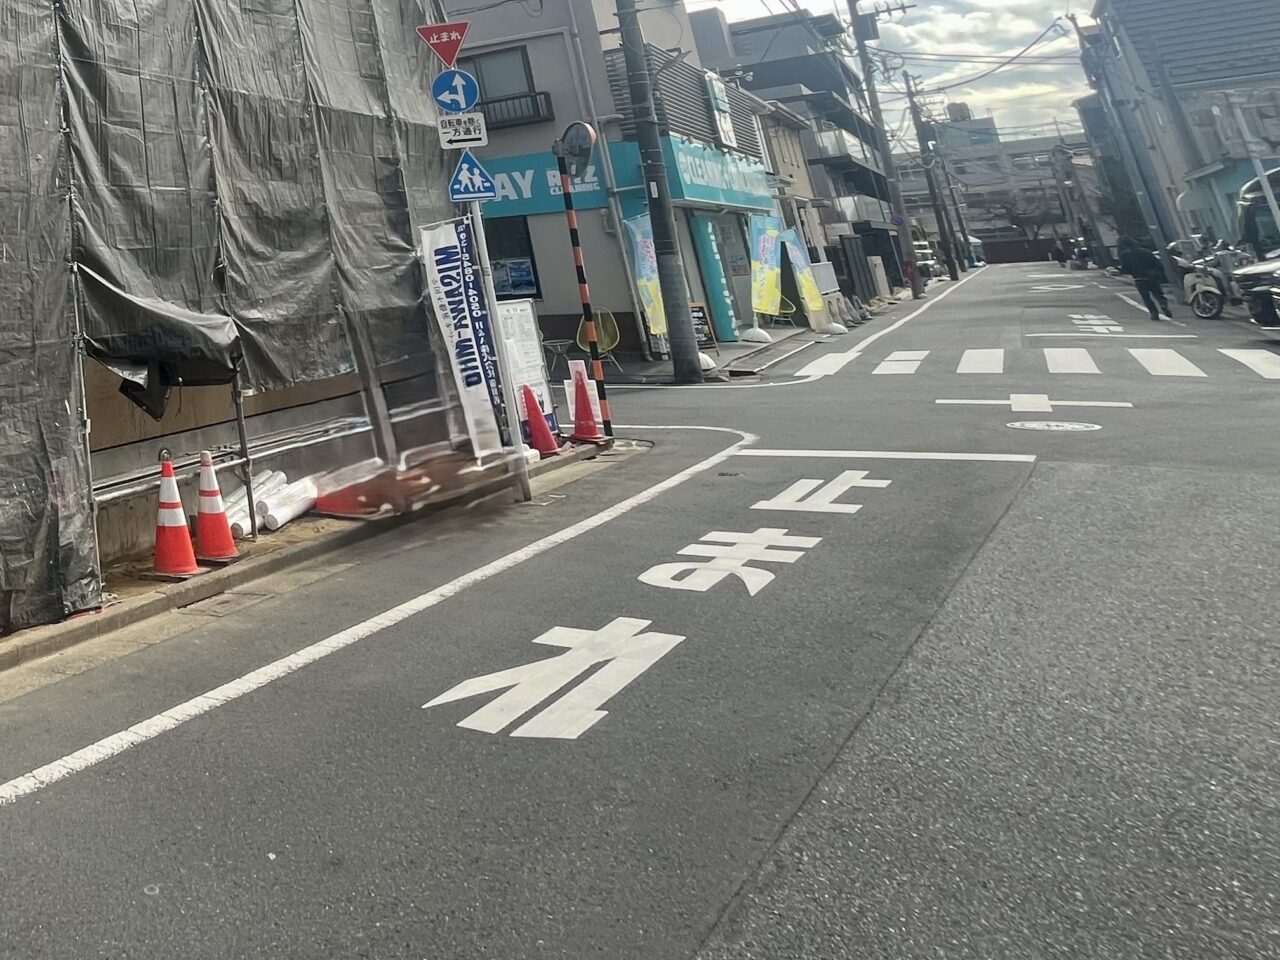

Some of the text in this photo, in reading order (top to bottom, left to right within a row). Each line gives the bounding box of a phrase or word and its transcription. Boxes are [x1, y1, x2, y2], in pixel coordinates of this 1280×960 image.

[429, 30, 462, 44] 止まれ
[440, 117, 481, 129] 自転車を除く
[442, 126, 482, 137] 一方通行
[493, 169, 535, 202] AY
